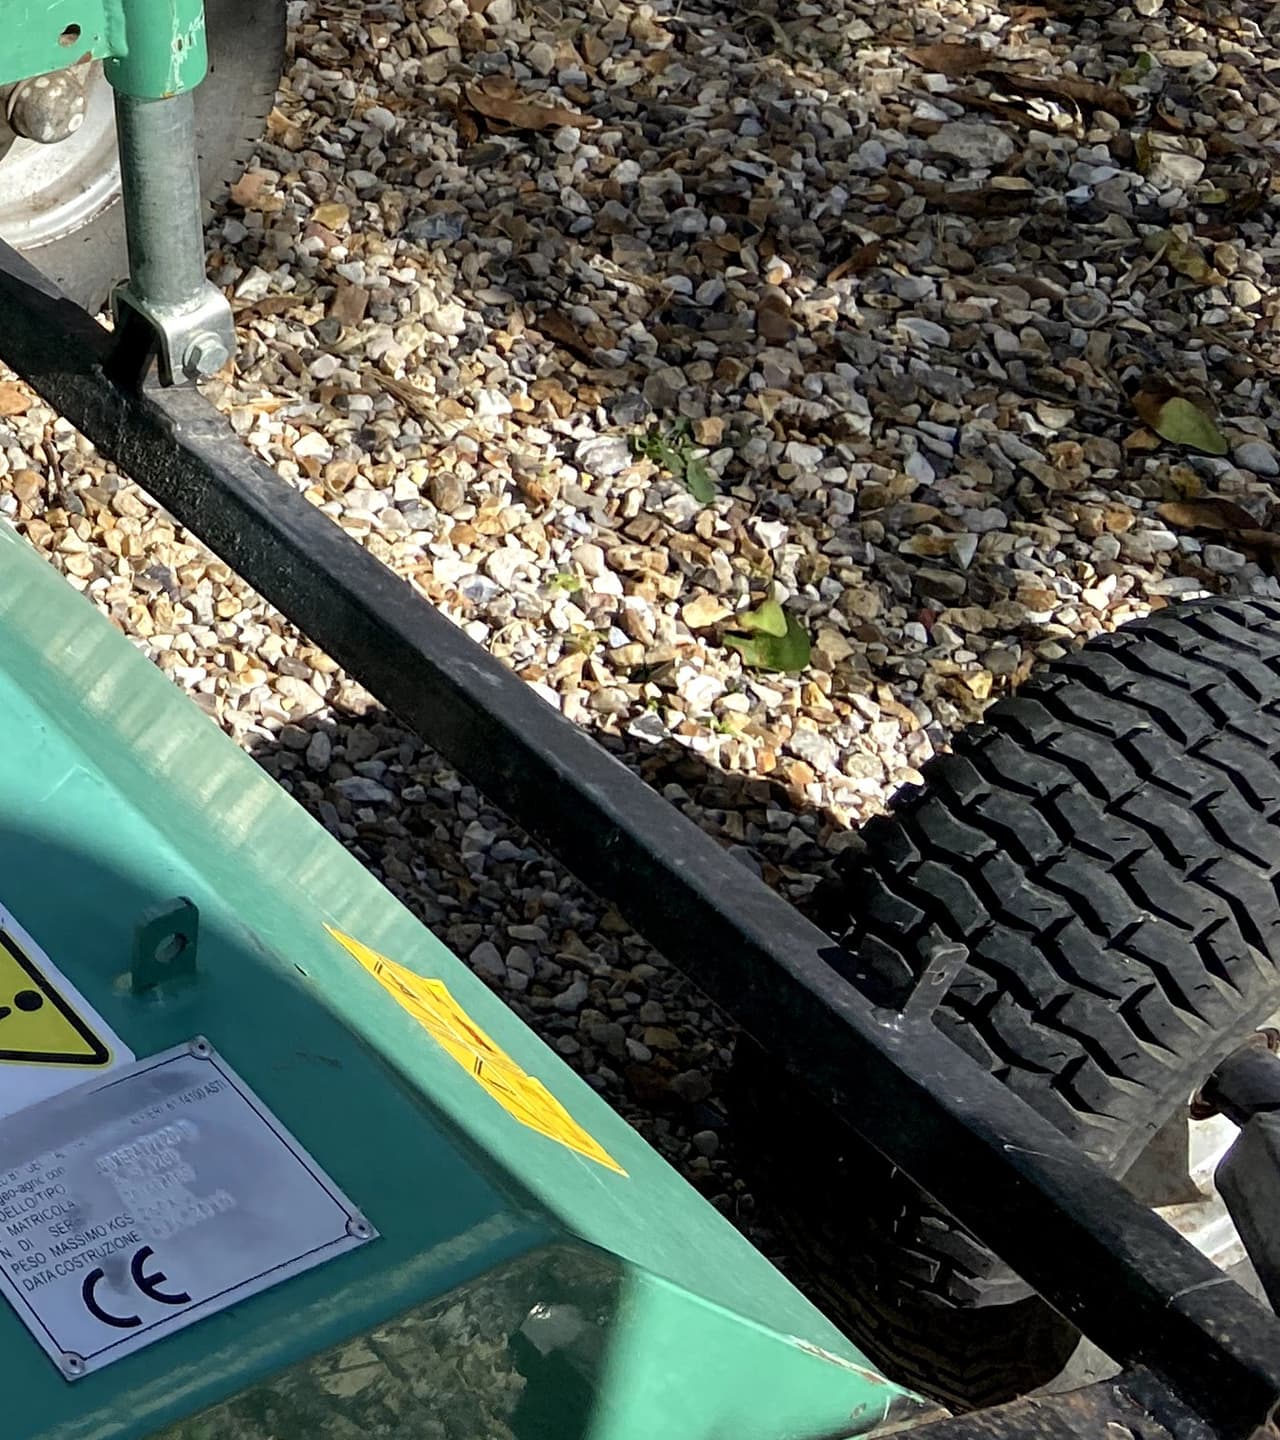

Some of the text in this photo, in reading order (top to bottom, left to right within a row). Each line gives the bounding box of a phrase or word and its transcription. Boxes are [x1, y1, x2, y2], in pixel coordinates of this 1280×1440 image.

[6, 1198, 77, 1235] MATRICOLA
[10, 1252, 46, 1275] PESO
[48, 1224, 107, 1257] MASSIMO
[105, 1212, 135, 1232] KGS
[17, 1237, 35, 1251] DI
[21, 1230, 142, 1291] DATA COSTRUZIONE
[82, 1246, 190, 1327] CE
